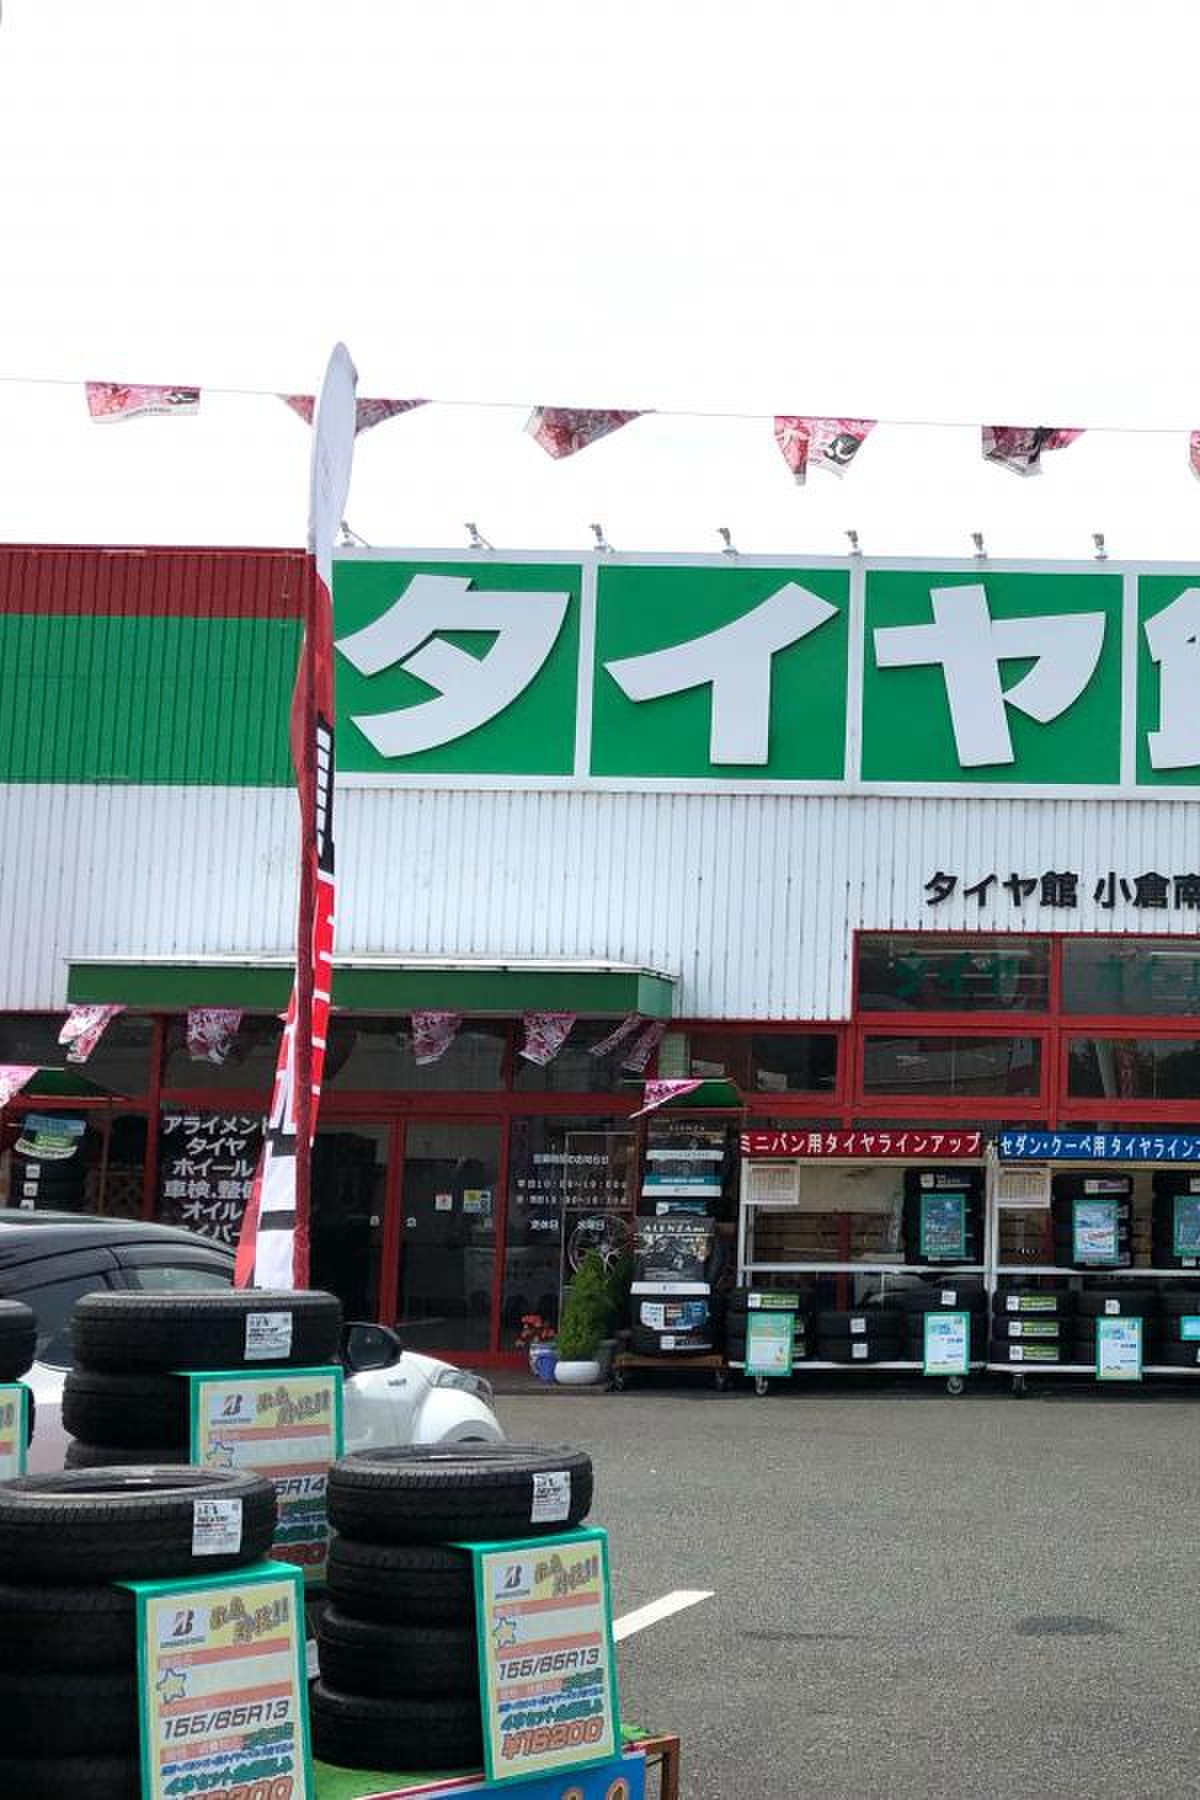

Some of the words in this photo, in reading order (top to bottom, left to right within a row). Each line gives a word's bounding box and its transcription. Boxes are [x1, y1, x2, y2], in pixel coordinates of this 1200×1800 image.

[924, 871, 1079, 908] タイヤ館
[185, 1137, 247, 1157] タイヤ
[172, 1157, 255, 1178] ホイール
[181, 1201, 243, 1221] オイル
